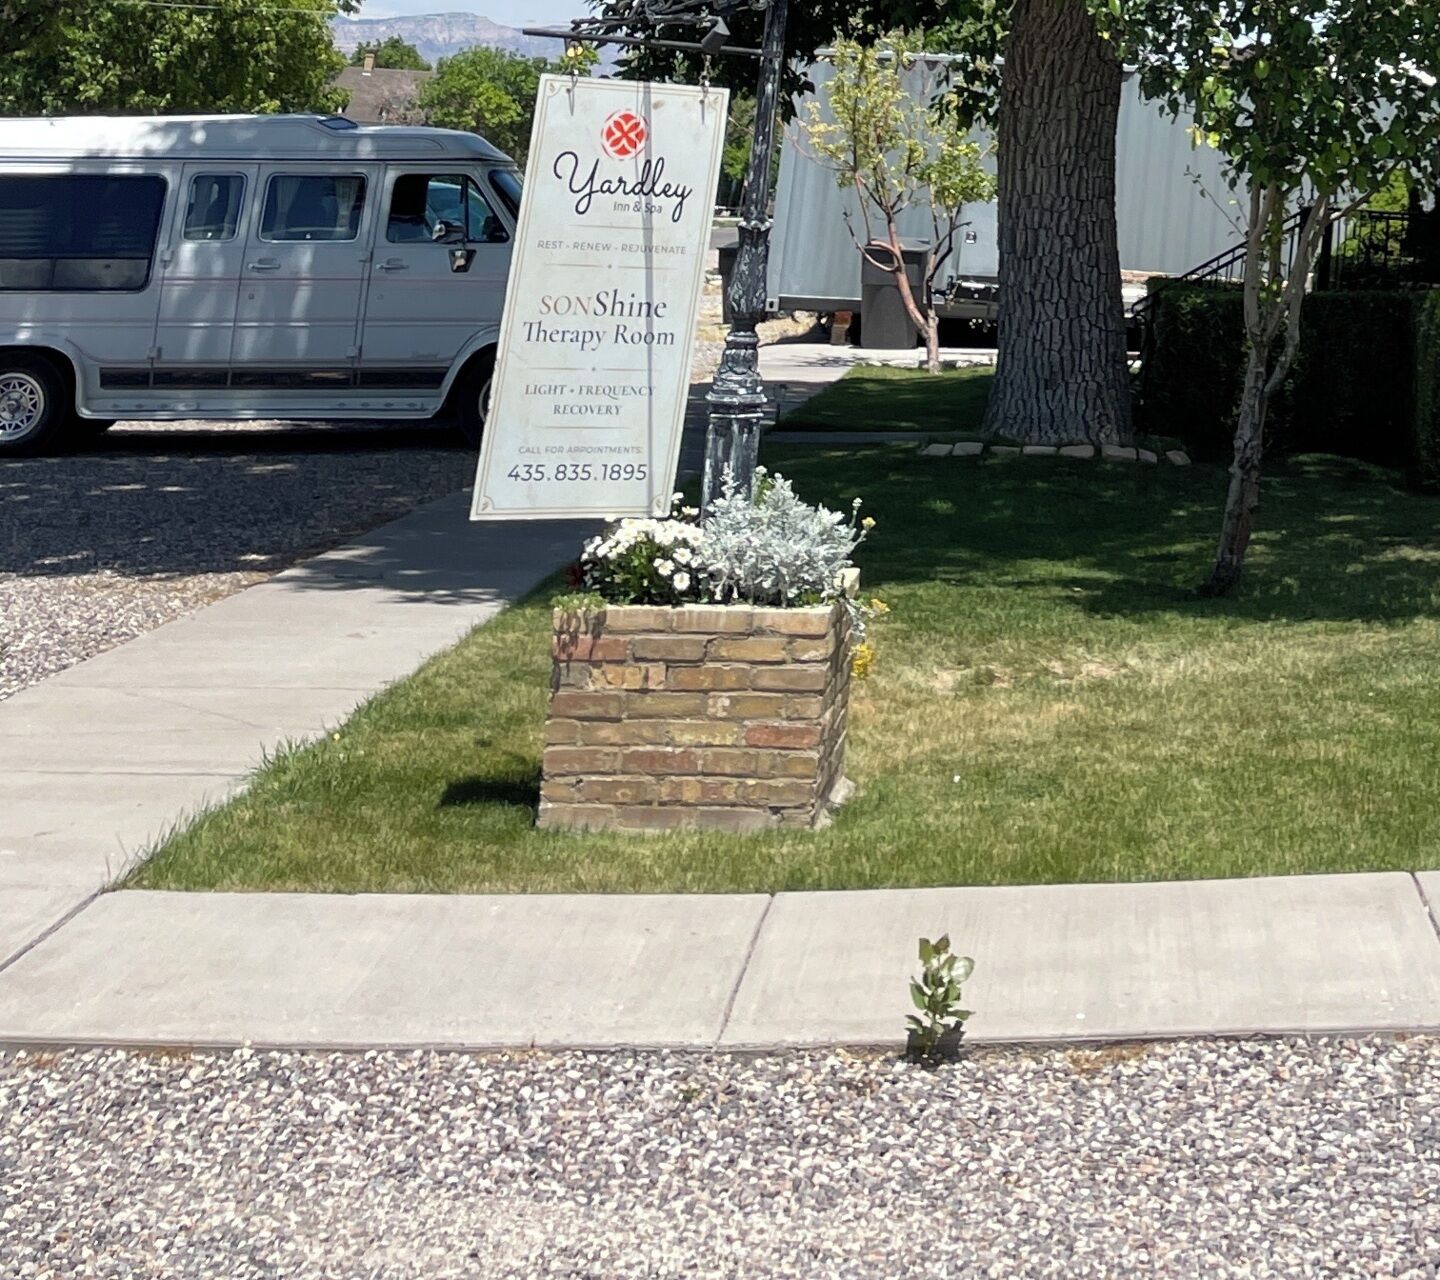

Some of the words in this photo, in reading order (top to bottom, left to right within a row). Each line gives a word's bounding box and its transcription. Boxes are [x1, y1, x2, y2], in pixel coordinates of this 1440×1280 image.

[553, 151, 693, 223] Yardley
[613, 201, 631, 212] Inn
[632, 202, 642, 213] &
[643, 203, 664, 215] Spa
[537, 239, 564, 250] REST
[572, 242, 613, 252] RENEW
[621, 244, 687, 255] REJUVENATE
[539, 288, 668, 318] SONShine
[523, 320, 607, 352] Therapy
[613, 324, 676, 346] Room
[525, 384, 567, 396] LIGHT
[578, 385, 657, 401] FREQUENCY
[553, 404, 622, 416] RECOVERY
[518, 446, 542, 455] CALL
[545, 447, 565, 455] FOR
[507, 463, 648, 482] 435.835.1895
